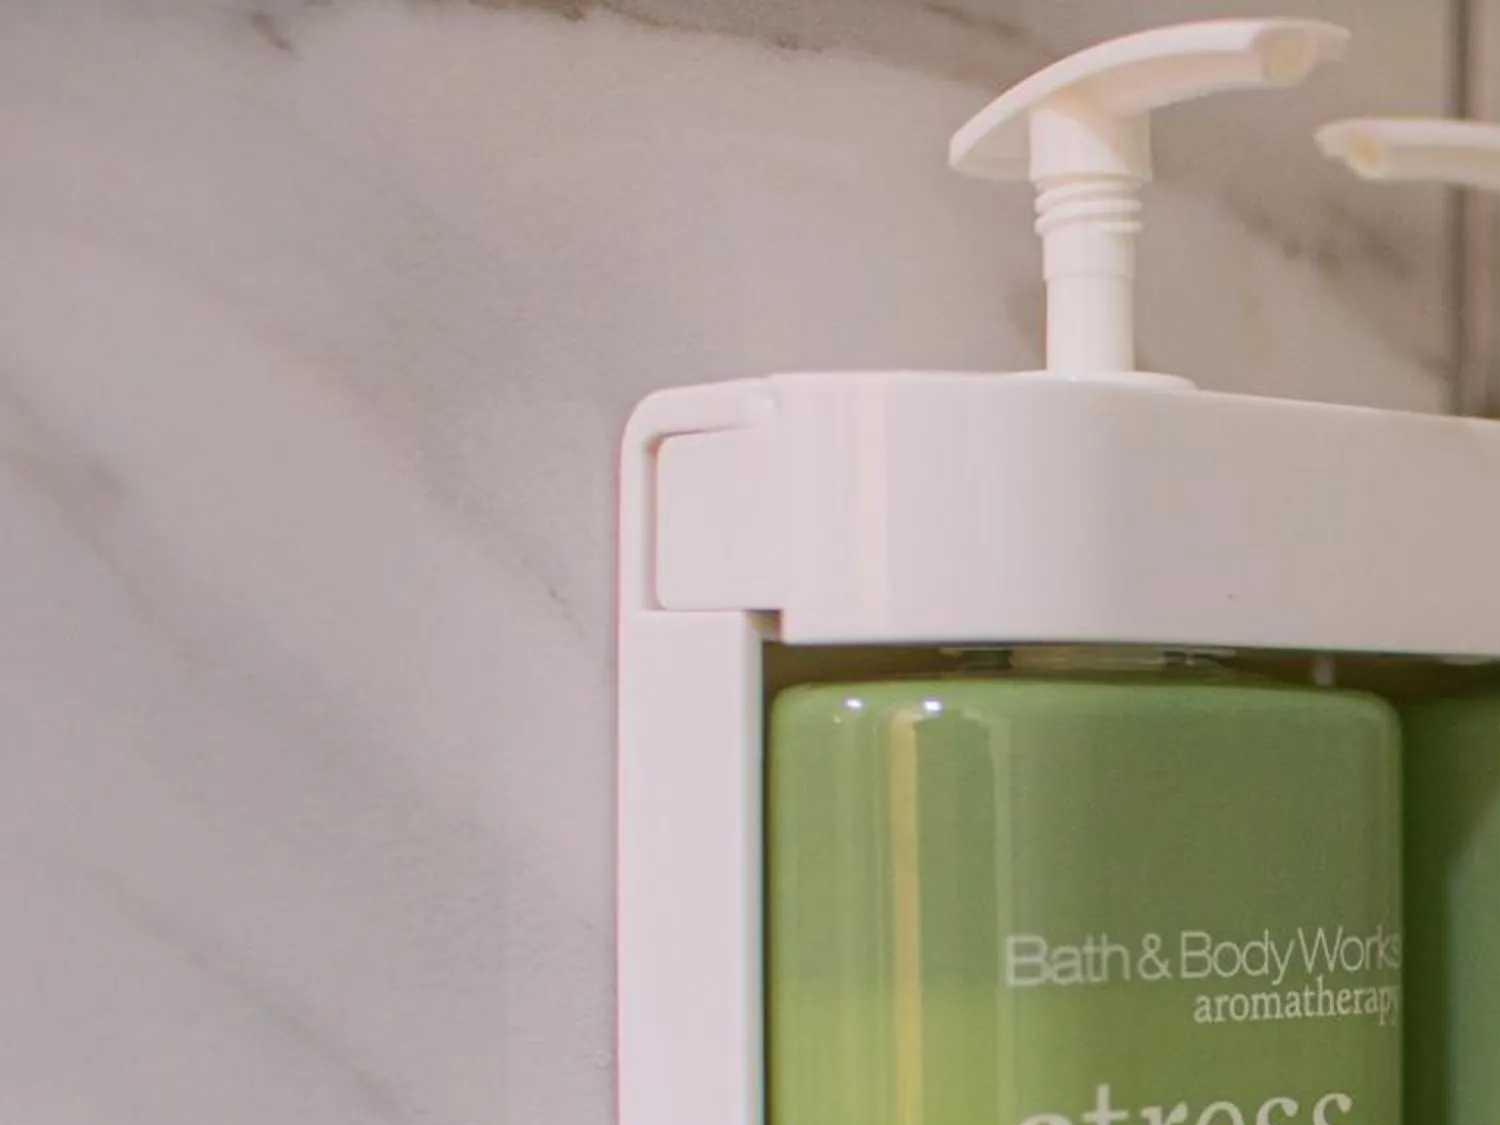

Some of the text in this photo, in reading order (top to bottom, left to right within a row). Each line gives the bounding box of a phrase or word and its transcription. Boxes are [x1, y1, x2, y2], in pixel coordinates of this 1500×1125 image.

[1006, 933, 1130, 987] Bath
[1138, 933, 1172, 981] &
[1181, 929, 1294, 985] Body
